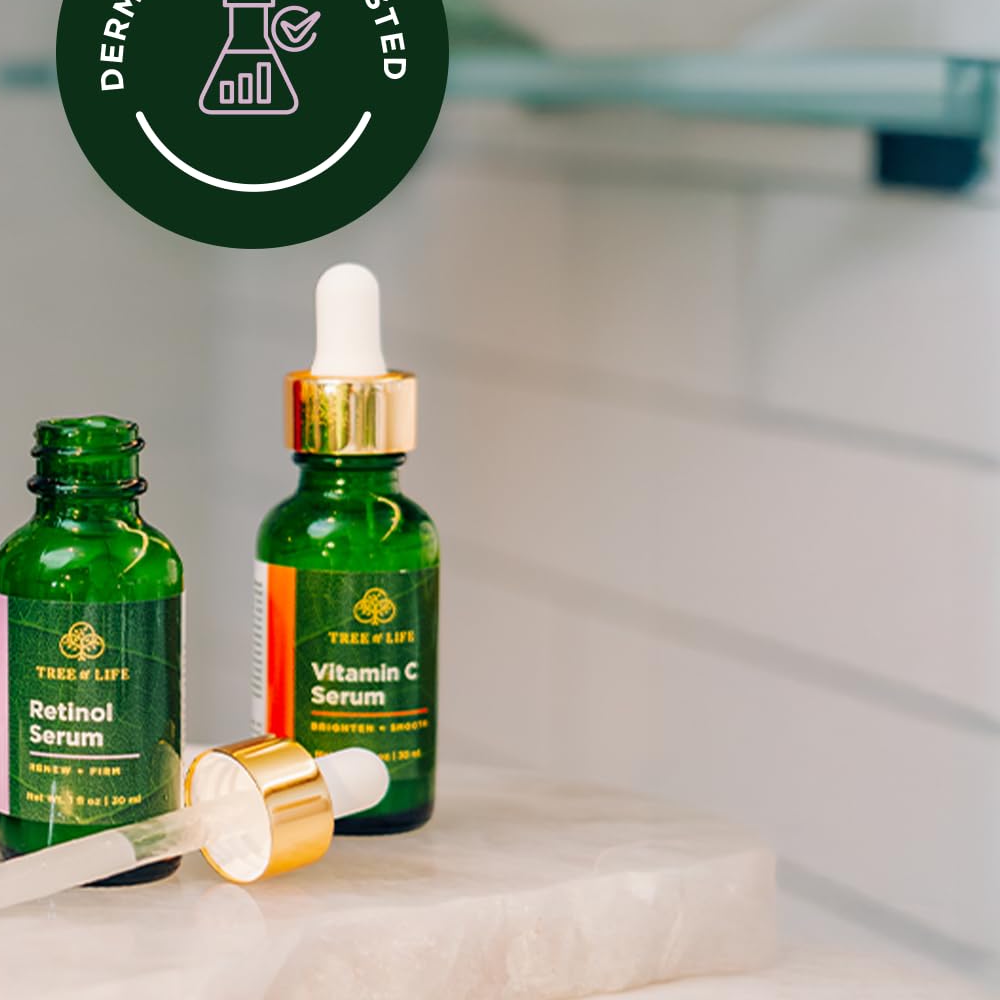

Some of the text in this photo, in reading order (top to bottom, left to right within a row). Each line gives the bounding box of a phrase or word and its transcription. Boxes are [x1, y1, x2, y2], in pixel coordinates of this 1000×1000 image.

[328, 632, 369, 644] TREE
[386, 631, 415, 644] LIFE
[36, 666, 77, 680] TREE
[94, 668, 130, 681] LIFE
[311, 661, 419, 682] Vitamin C
[311, 686, 385, 706] Serum
[29, 699, 113, 722] Retinol
[311, 721, 375, 733] BRIGHTEN
[29, 725, 104, 747] Serum
[29, 762, 71, 776] RENEW
[89, 766, 121, 776] FIRM
